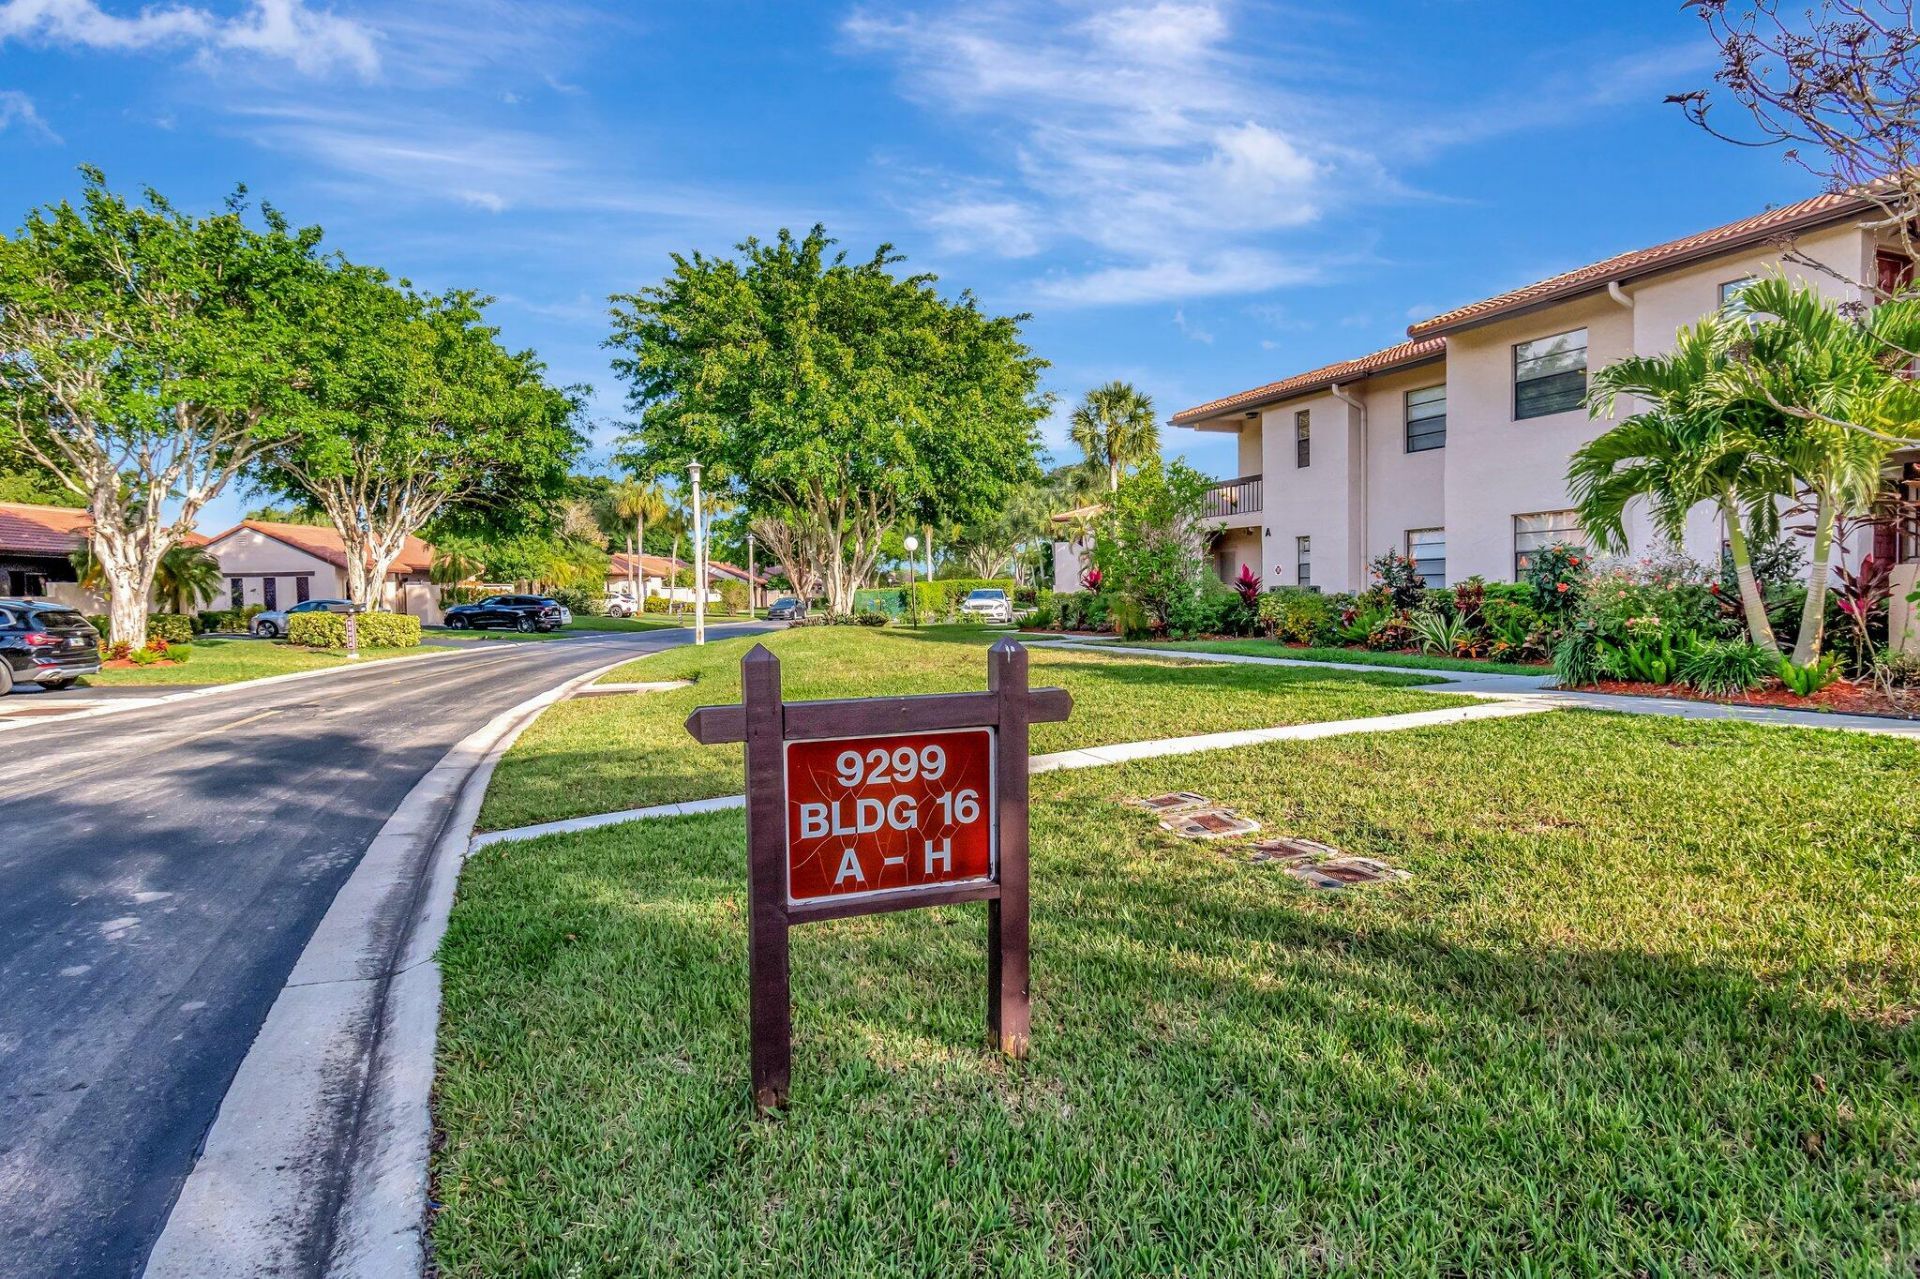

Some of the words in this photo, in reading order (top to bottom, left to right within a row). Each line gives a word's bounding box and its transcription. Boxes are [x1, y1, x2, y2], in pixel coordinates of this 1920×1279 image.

[1265, 527, 1271, 537] A
[836, 744, 946, 787] 9299
[800, 795, 918, 839] BLDG
[936, 788, 980, 825] 16
[834, 848, 865, 885] A
[883, 856, 904, 866] -
[924, 837, 951, 874] H
